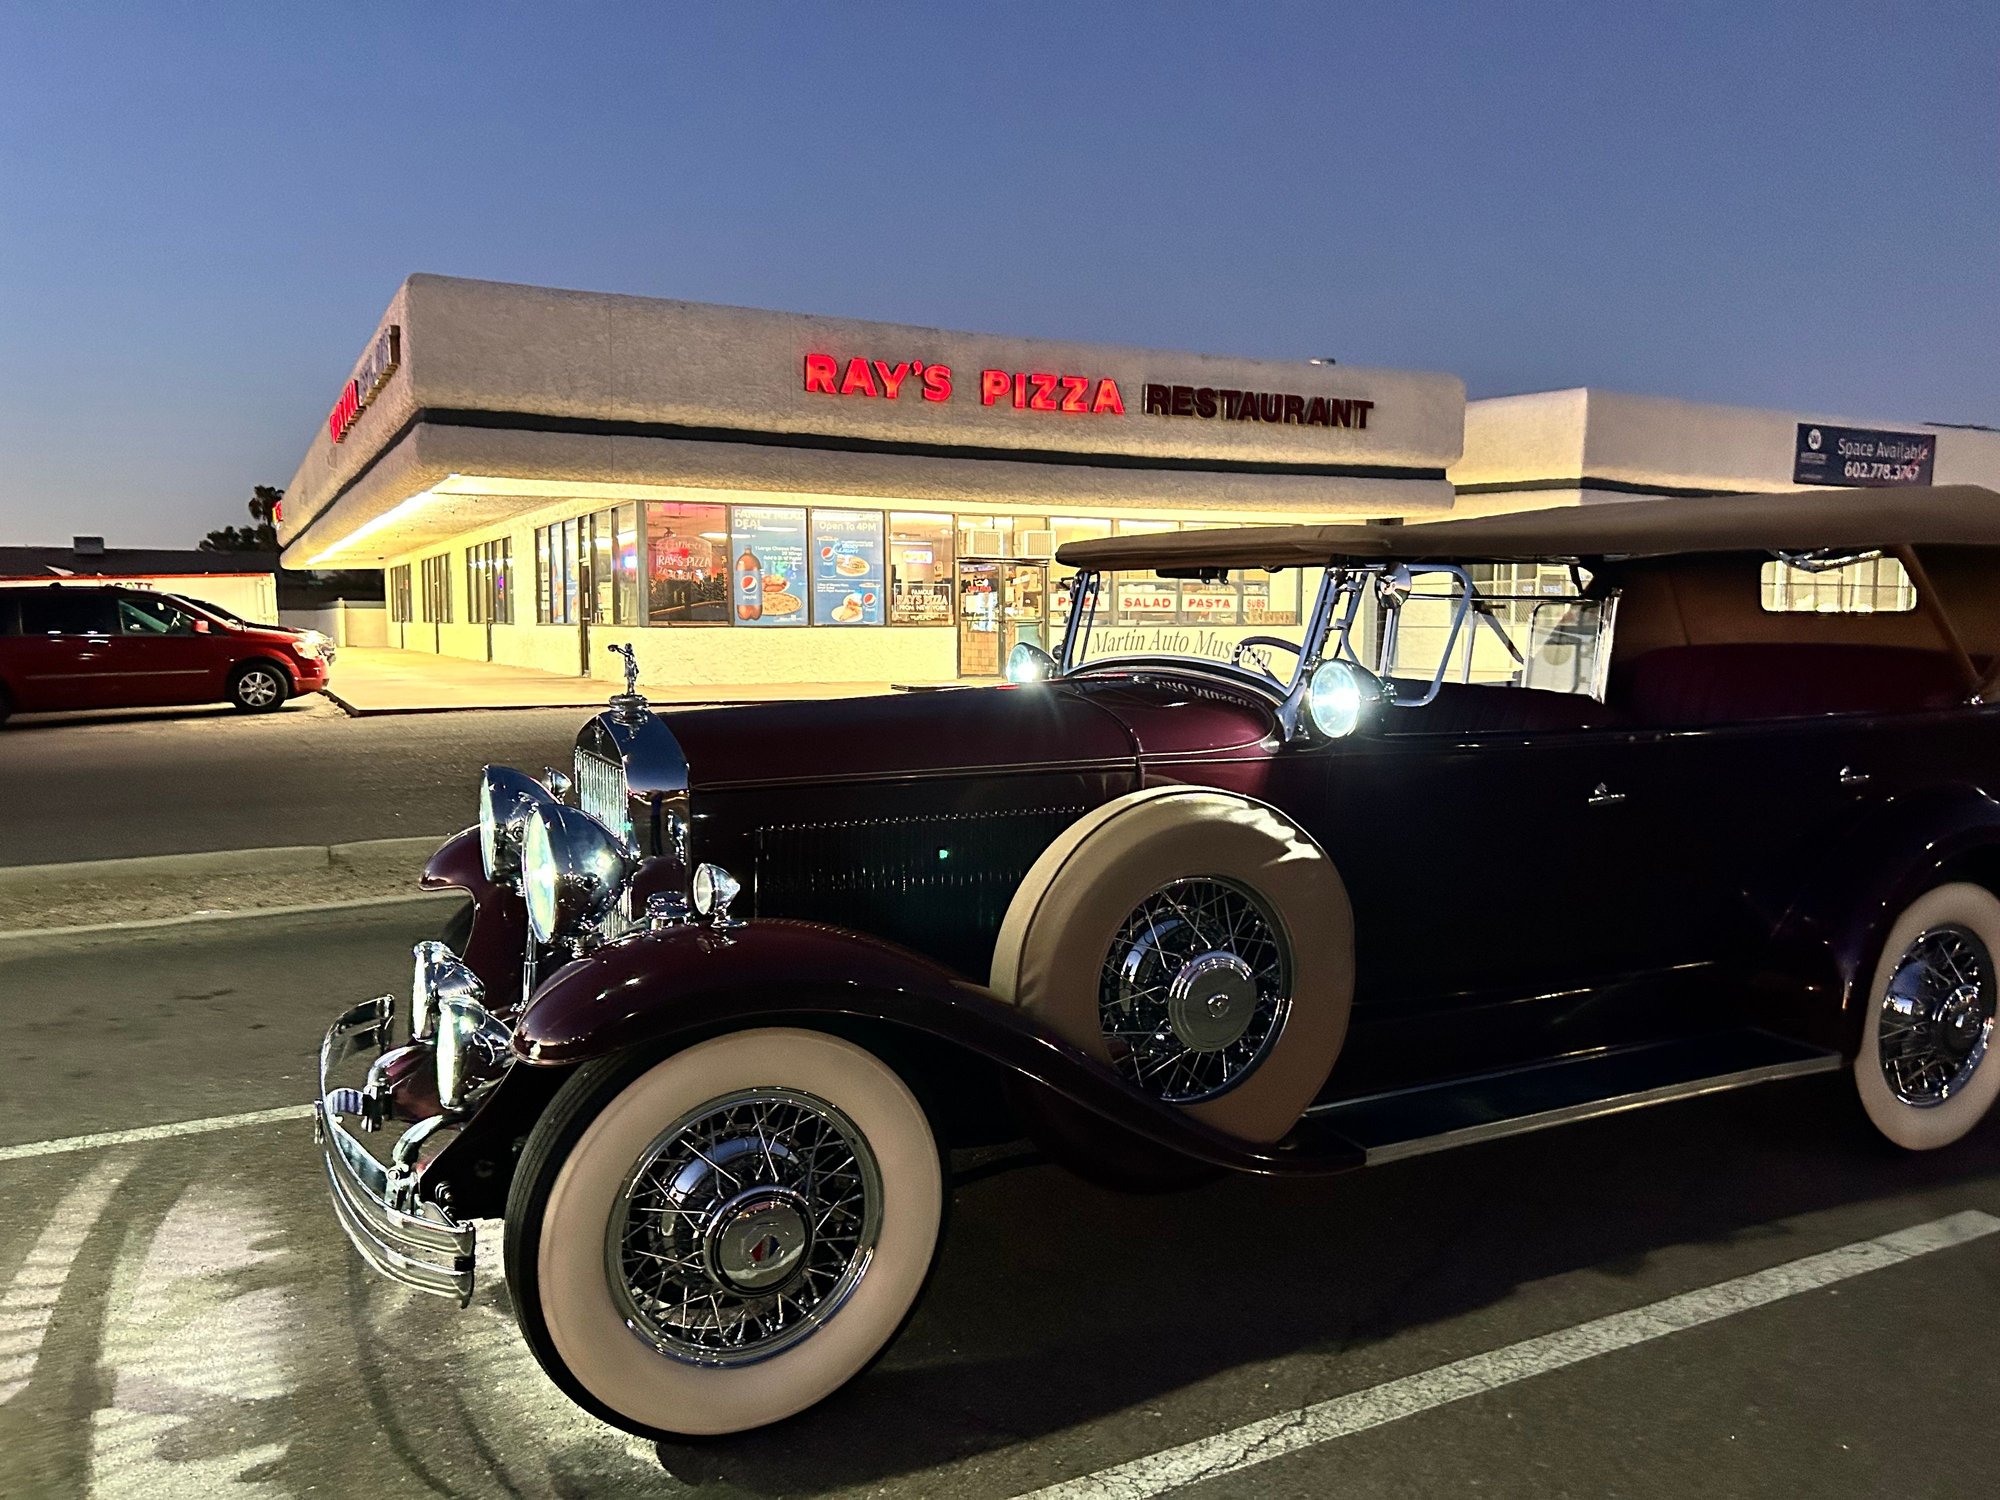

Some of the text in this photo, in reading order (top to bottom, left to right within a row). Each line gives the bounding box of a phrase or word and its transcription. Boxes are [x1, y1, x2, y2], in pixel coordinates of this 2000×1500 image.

[803, 353, 1375, 430] RAY'S PIZZA RESTAURANT
[1838, 438, 1874, 459] Space
[1877, 441, 1928, 462] Available
[819, 521, 843, 532] Open
[856, 522, 877, 531] 4PM
[658, 555, 711, 568] RAY'S PIZZA
[924, 595, 948, 605] PIZZA
[1124, 597, 1171, 608] SALAD
[1188, 598, 1231, 608] PASTA
[1247, 599, 1265, 609] SUBS
[1091, 628, 1145, 654] Martin
[1149, 628, 1190, 653] Auto
